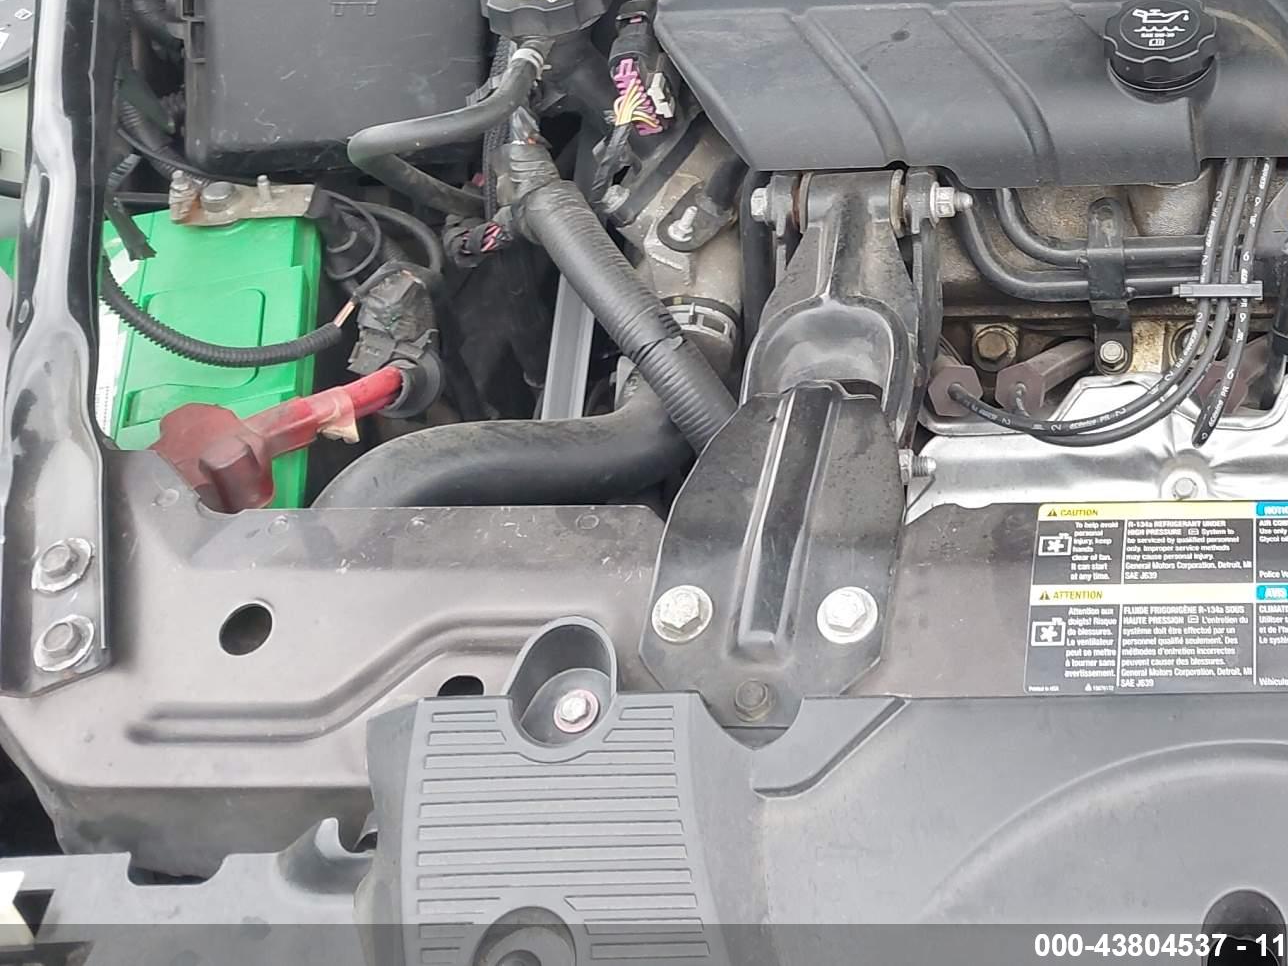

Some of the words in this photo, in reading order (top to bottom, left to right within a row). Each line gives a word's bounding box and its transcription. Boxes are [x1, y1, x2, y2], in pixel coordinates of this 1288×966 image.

[1259, 570, 1280, 578] Police
[1053, 591, 1103, 599] ATTENTION
[1124, 606, 1149, 614] FLUIDE
[1123, 616, 1147, 624] HAUTE
[1148, 616, 1184, 624] PRESSION
[1121, 679, 1135, 687] SAE
